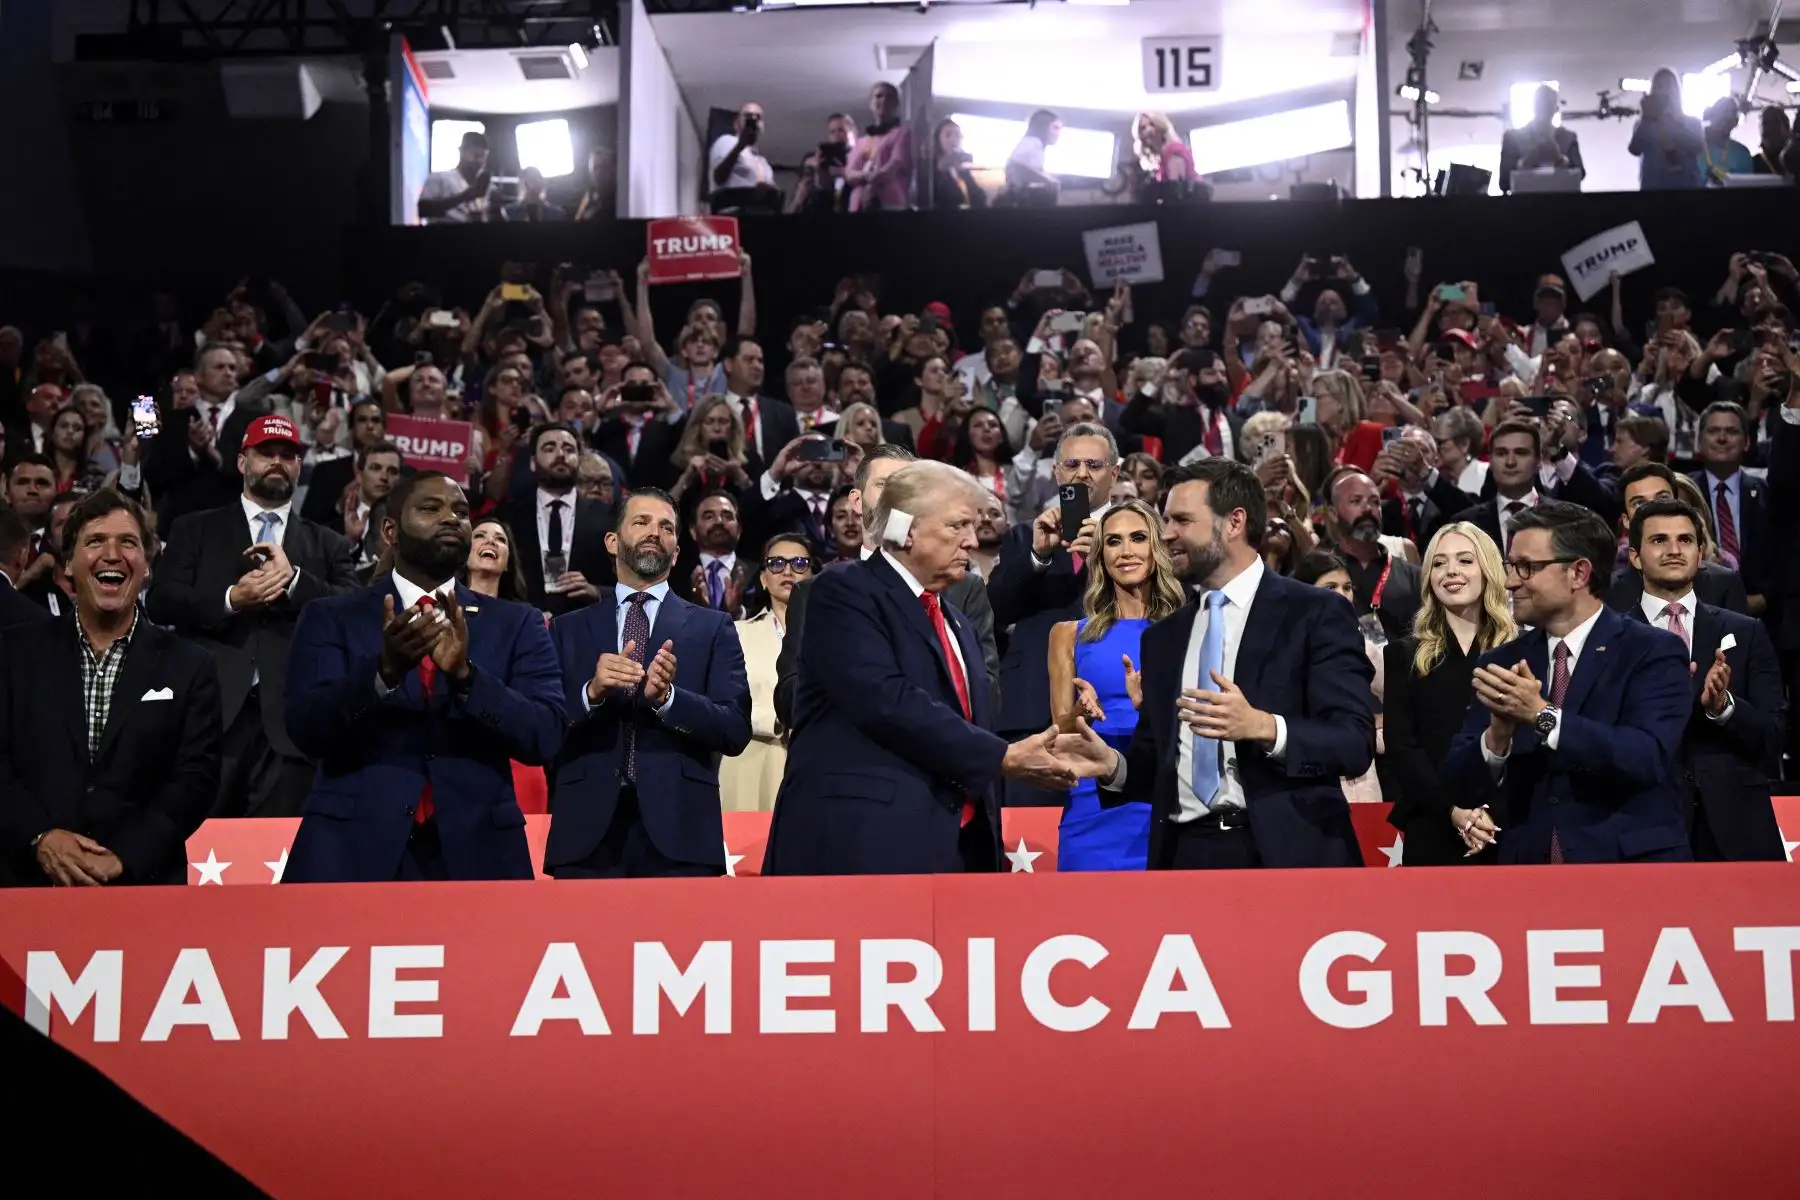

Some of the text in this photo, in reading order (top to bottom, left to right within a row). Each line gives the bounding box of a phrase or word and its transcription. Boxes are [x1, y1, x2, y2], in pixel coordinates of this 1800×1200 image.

[1155, 46, 1211, 88] 115
[653, 235, 733, 254] TRUMP
[1573, 238, 1638, 275] TRUMP
[263, 426, 292, 437] TRUMP
[25, 925, 1800, 1042] MAKE AMERICA GREAT
